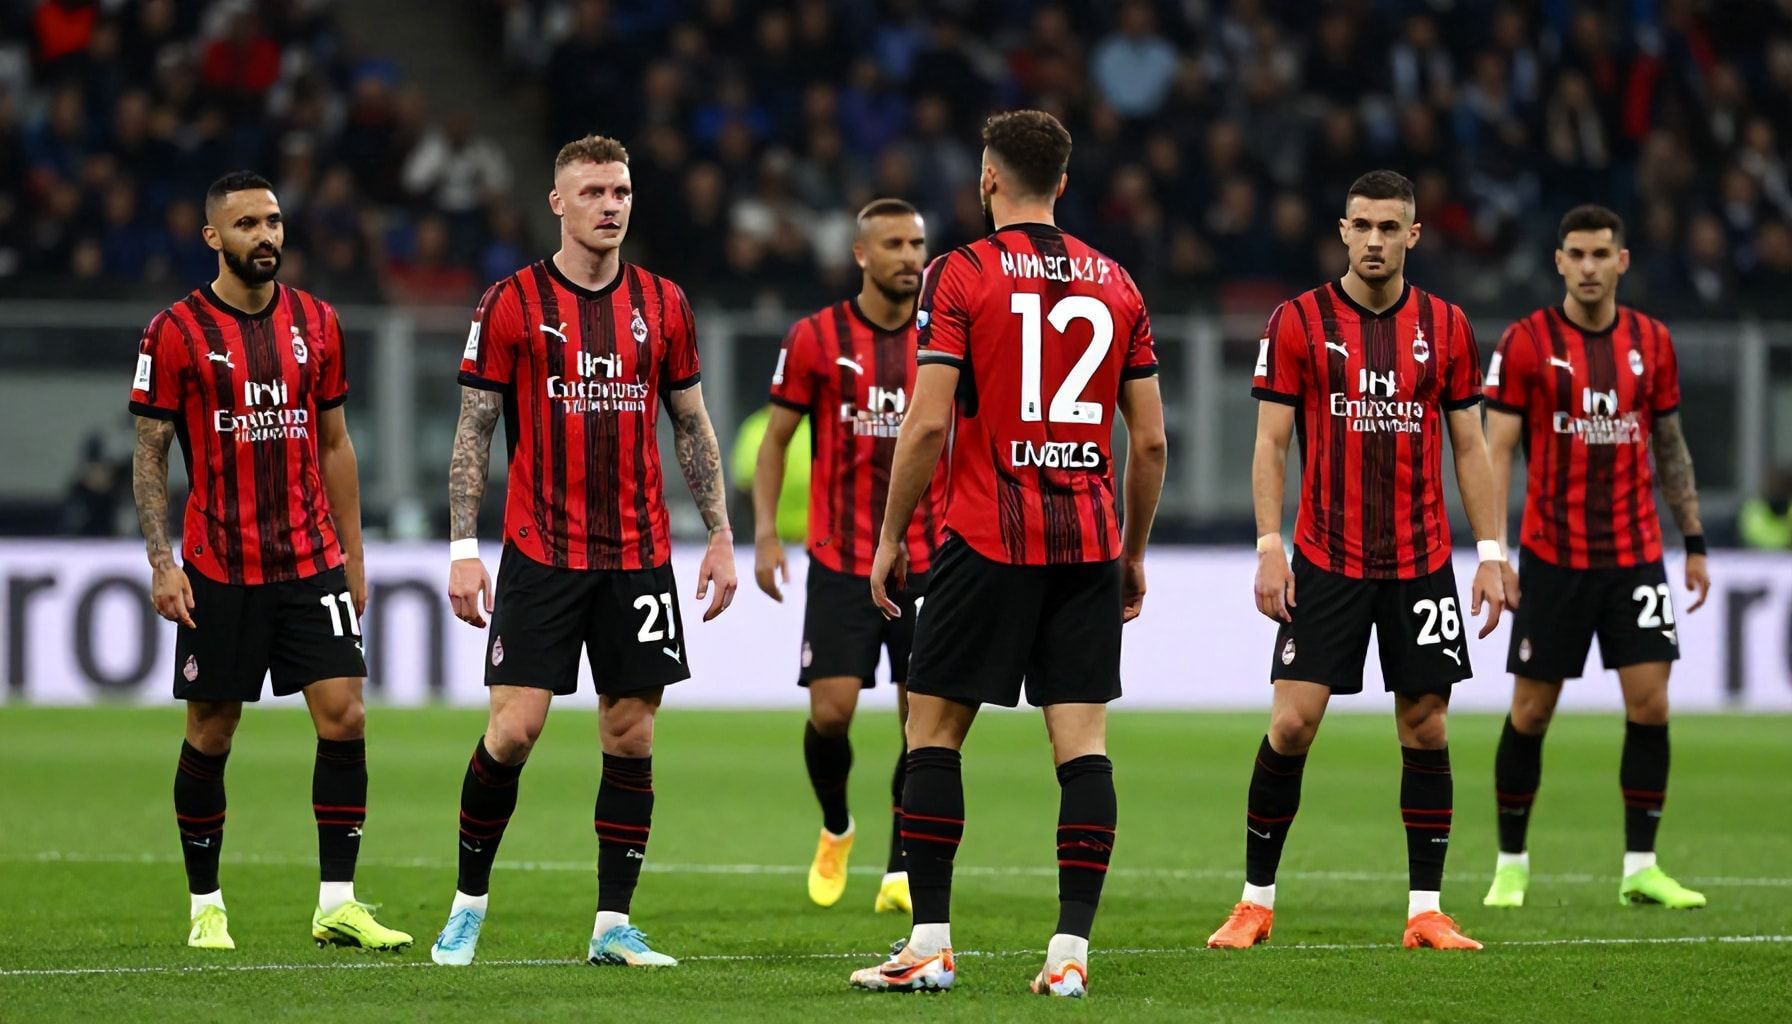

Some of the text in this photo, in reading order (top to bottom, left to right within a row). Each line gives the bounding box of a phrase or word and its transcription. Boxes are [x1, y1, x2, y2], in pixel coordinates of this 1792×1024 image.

[1010, 292, 1114, 425] 12
[320, 591, 361, 636] 11
[633, 592, 676, 643] 21
